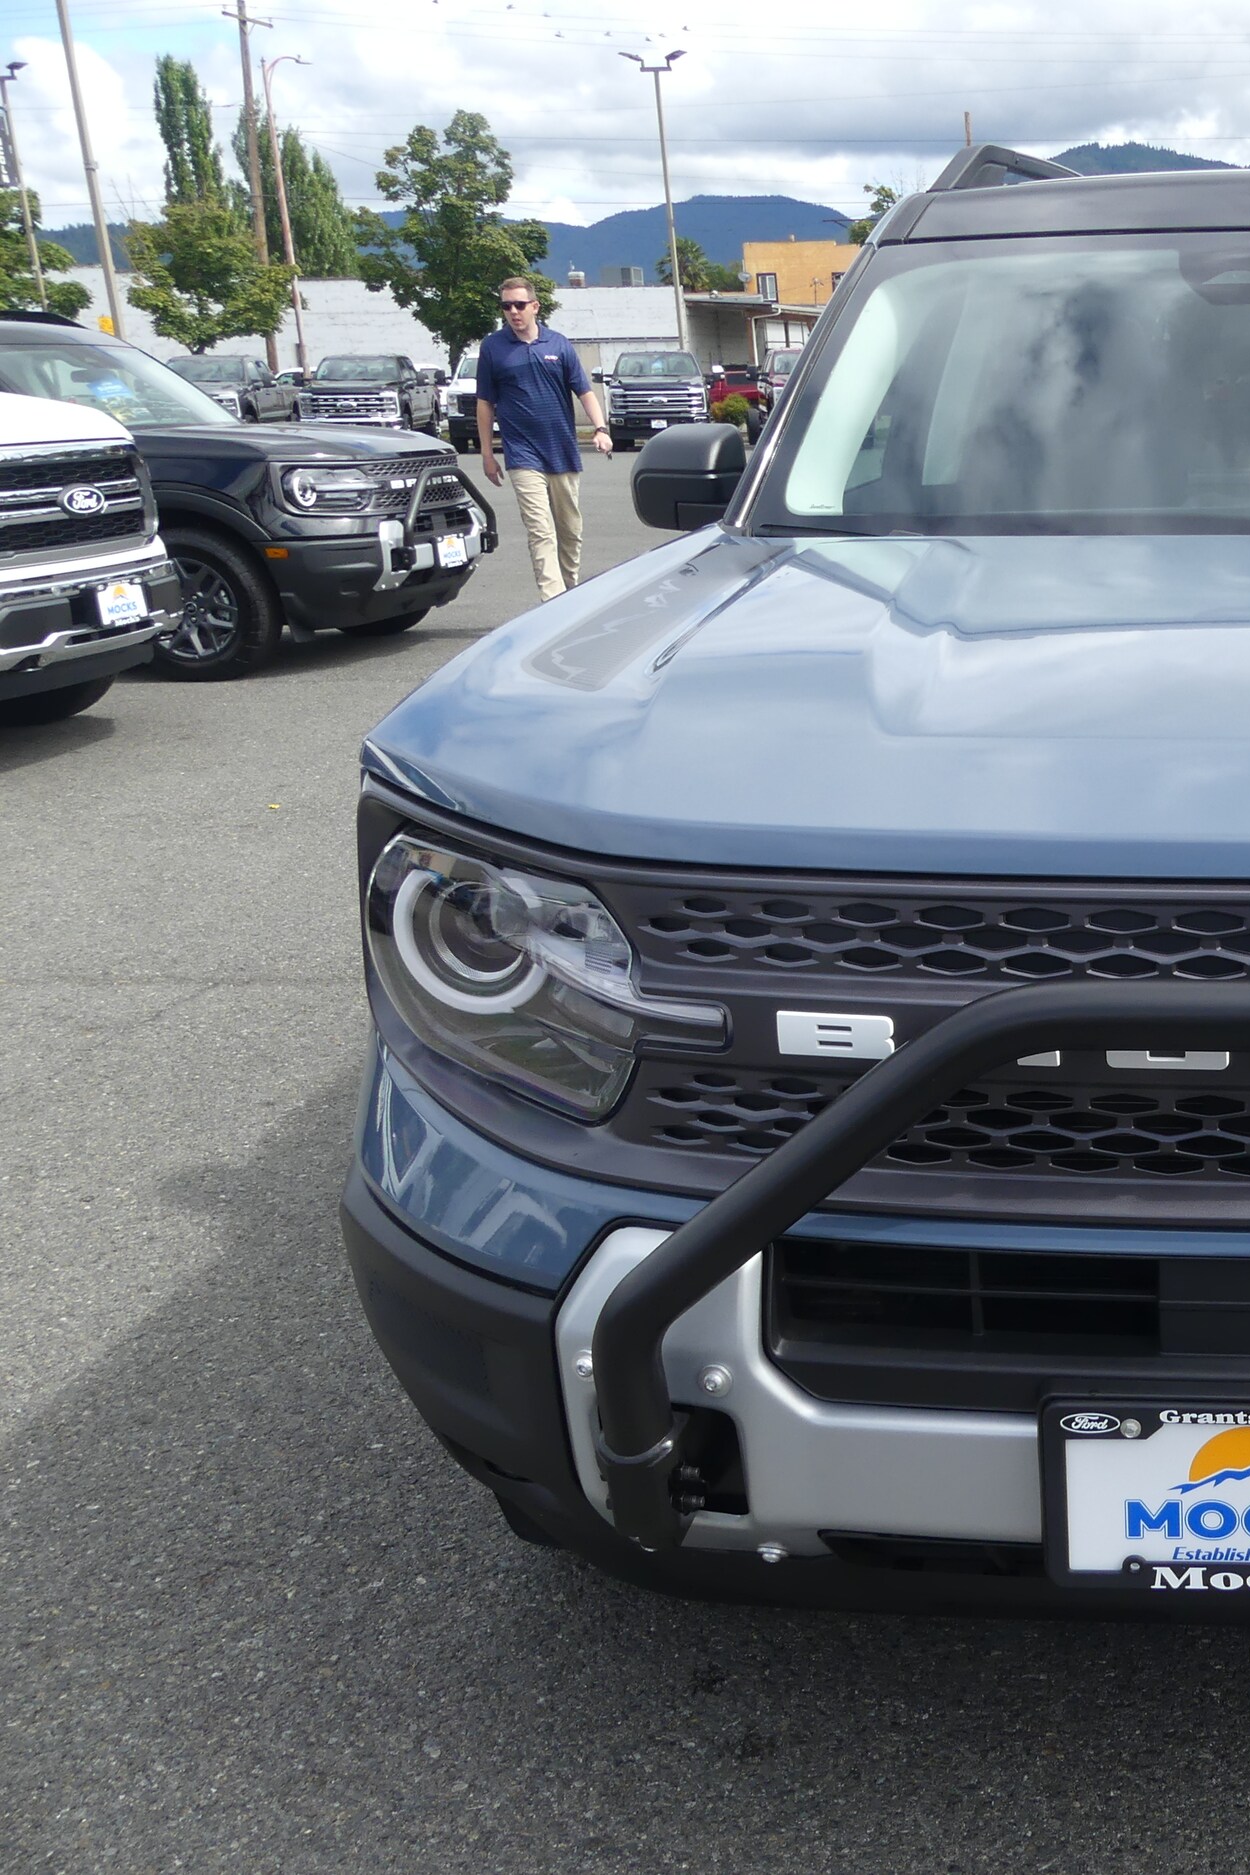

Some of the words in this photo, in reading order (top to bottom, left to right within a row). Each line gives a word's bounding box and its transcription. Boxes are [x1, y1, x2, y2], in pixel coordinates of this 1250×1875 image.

[72, 491, 98, 509] Ford
[107, 602, 137, 615] MOCKS
[1071, 1416, 1108, 1431] Ford
